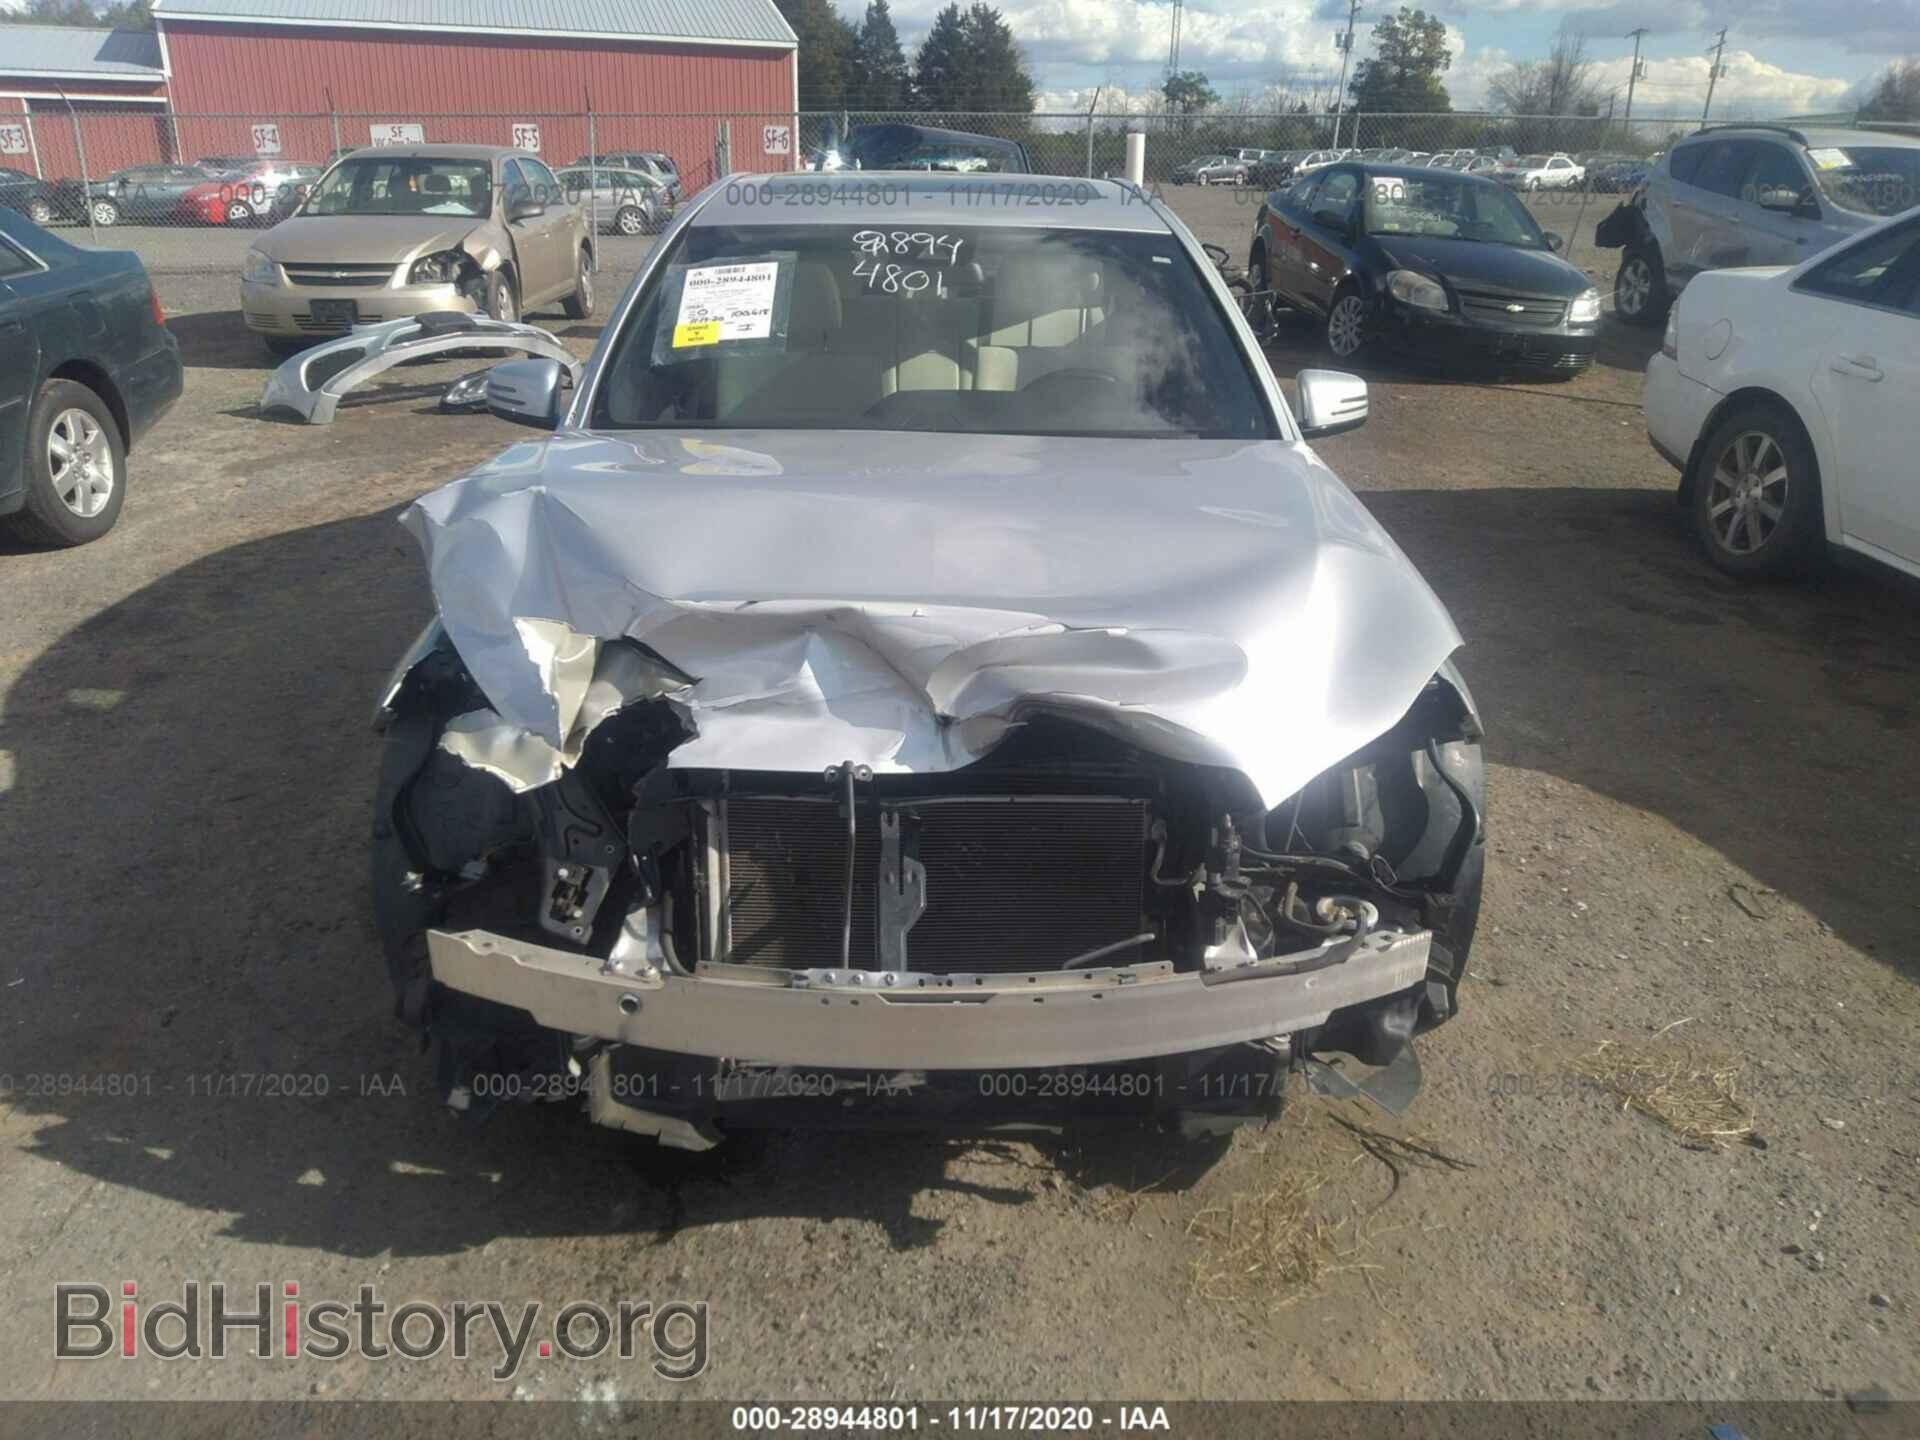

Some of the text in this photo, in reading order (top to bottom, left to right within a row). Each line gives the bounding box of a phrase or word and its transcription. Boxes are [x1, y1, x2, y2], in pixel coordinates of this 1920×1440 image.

[0, 128, 25, 149] SF-3
[255, 128, 279, 149] SF-4
[514, 127, 538, 149] SF-5
[764, 129, 789, 150] SF-6
